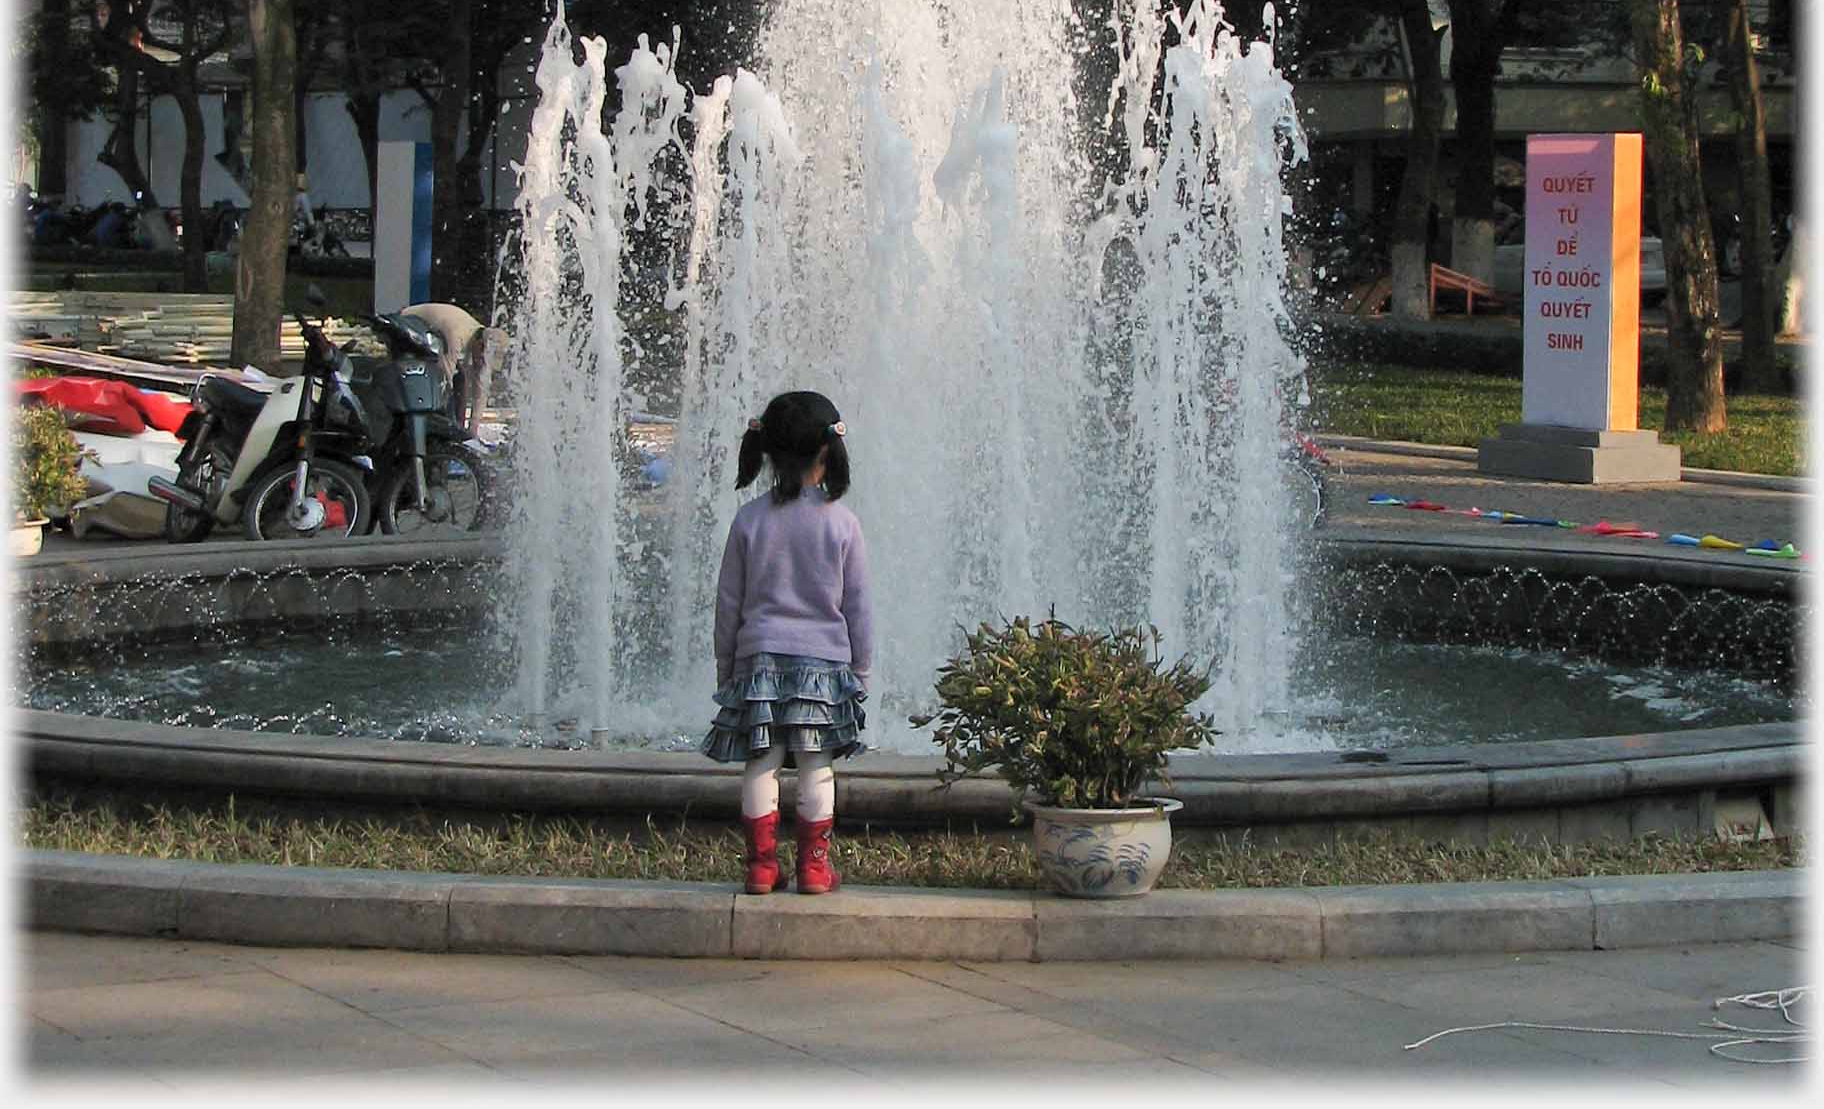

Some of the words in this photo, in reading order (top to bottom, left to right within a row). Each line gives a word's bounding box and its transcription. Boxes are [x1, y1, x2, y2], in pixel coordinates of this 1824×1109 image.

[1557, 263, 1601, 287] QUỐC
[1541, 296, 1592, 319] QUYẾT
[1547, 333, 1583, 350] SINH
